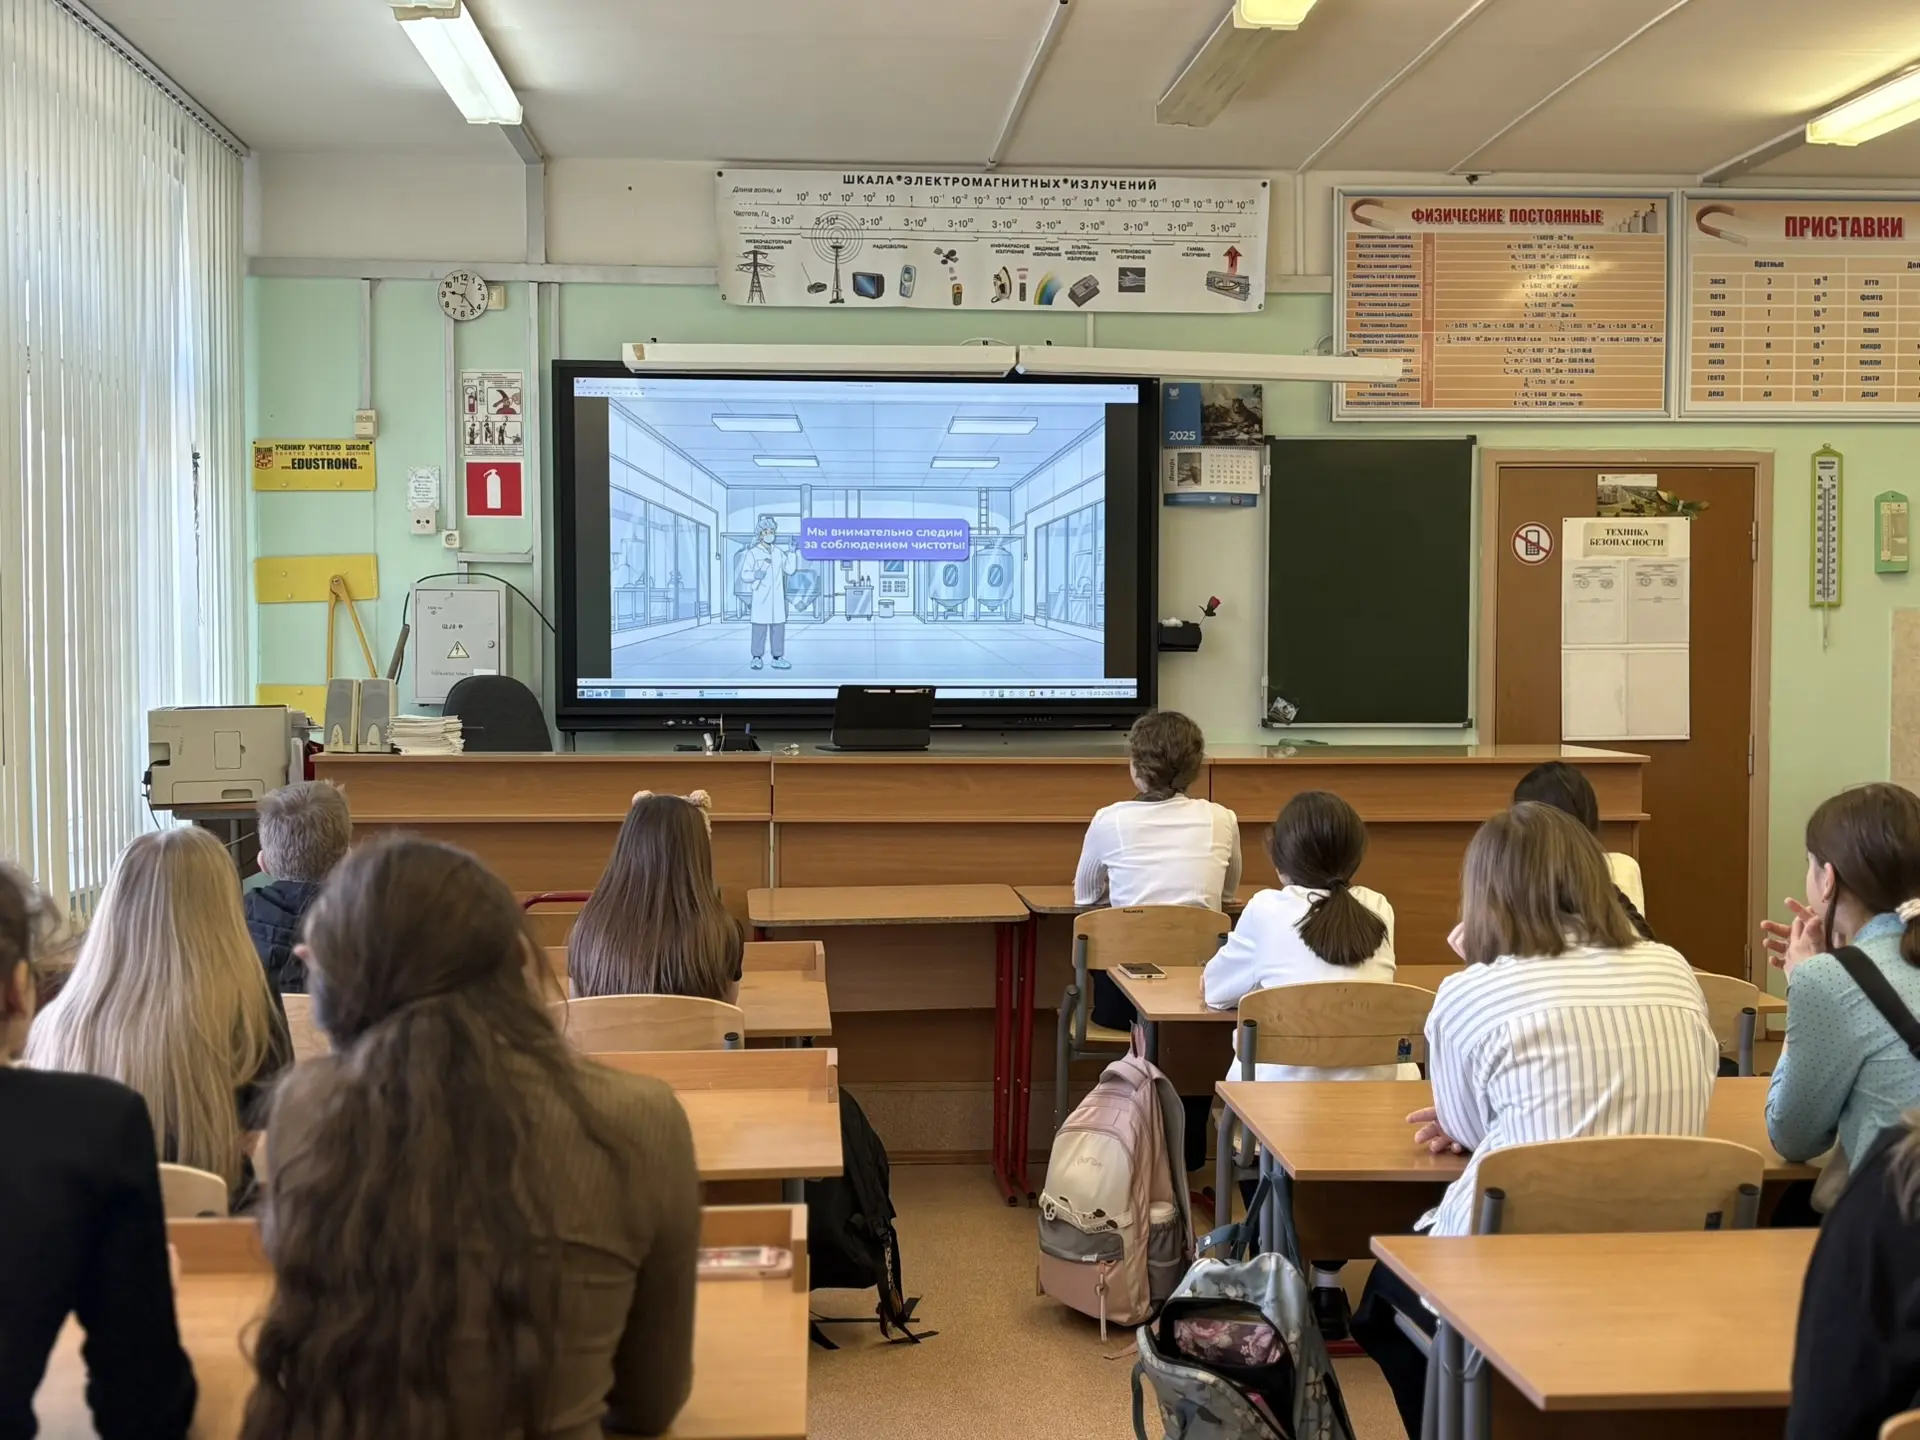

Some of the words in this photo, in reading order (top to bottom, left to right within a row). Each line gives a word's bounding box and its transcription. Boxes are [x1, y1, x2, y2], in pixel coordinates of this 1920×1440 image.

[843, 174, 894, 184] ШКАЛА
[904, 176, 1060, 188] ЭЛЕКТРОМАГНИТНЫХ
[1070, 178, 1156, 190] ИЗЛУЧЕНИЙ
[1412, 208, 1504, 223] ФИЗИЧЕСКИЕ
[1509, 209, 1602, 224] ПОСТОЯННЫЕ
[1784, 216, 1904, 239] ПРИСТАВКИ
[1169, 431, 1196, 440] 2025
[807, 527, 827, 536] Мы
[831, 528, 913, 537] внимательно
[916, 529, 963, 538] следим
[804, 540, 818, 549] за
[821, 540, 907, 551] соблюдением
